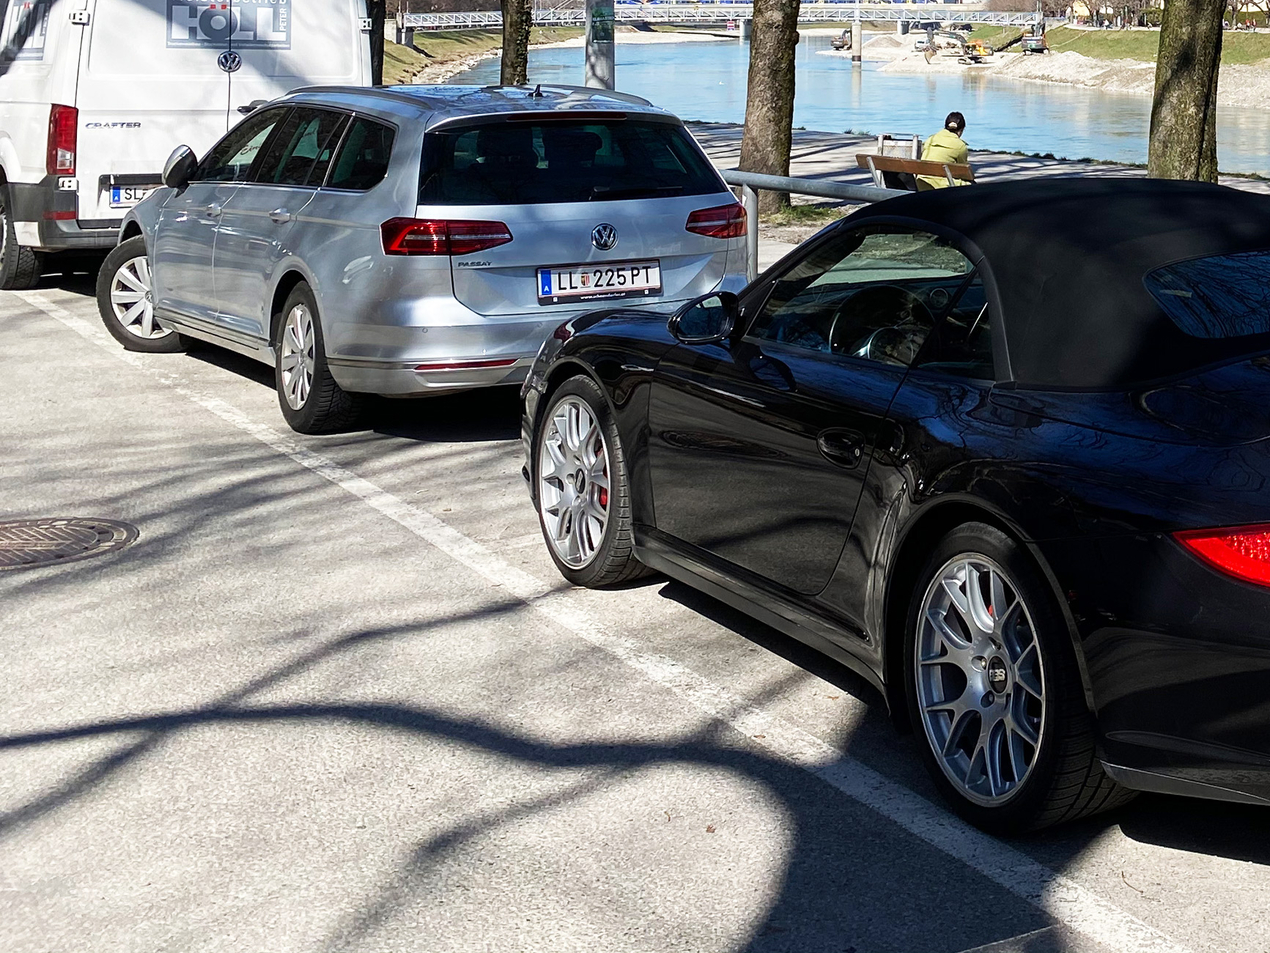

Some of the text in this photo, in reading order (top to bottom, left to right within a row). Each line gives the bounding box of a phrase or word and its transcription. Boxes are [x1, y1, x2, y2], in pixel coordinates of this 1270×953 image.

[171, 4, 287, 41] HÖLL
[279, 8, 287, 31] PETER
[558, 272, 578, 290] LL
[593, 267, 627, 288] 225
[631, 266, 651, 285] PT
